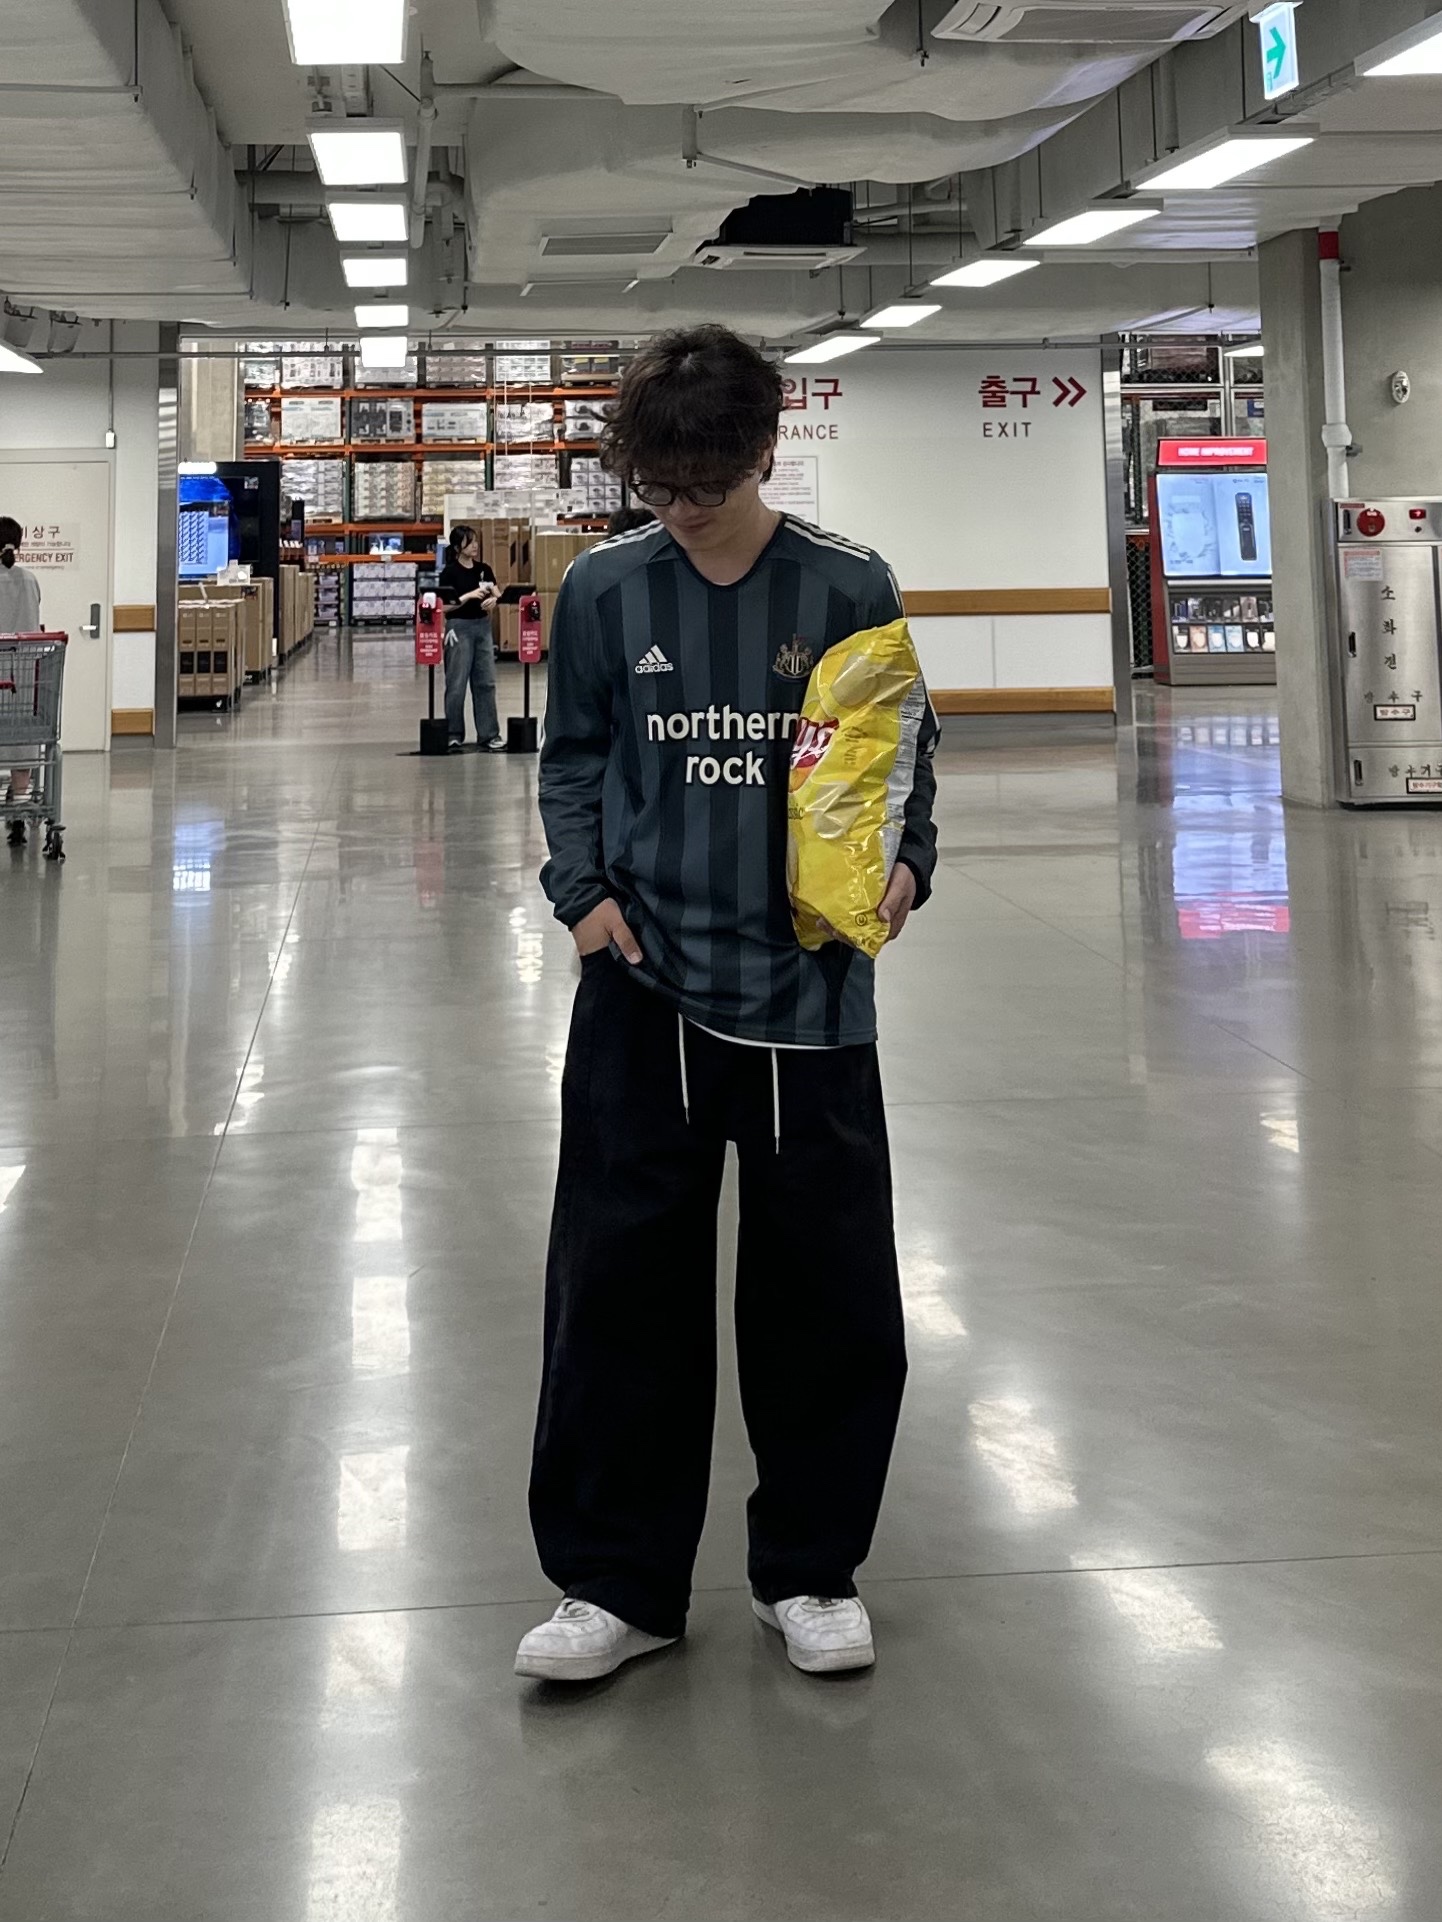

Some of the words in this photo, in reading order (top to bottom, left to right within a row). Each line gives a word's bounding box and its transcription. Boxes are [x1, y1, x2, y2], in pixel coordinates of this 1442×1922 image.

[783, 377, 843, 410] 입구
[978, 375, 1041, 408] 출구
[777, 424, 839, 440] RANCE
[982, 422, 1032, 438] EXIT
[15, 553, 53, 563] ERGENCY
[55, 552, 74, 563] EXIT
[634, 662, 674, 674] adidas
[685, 751, 766, 786] rock
